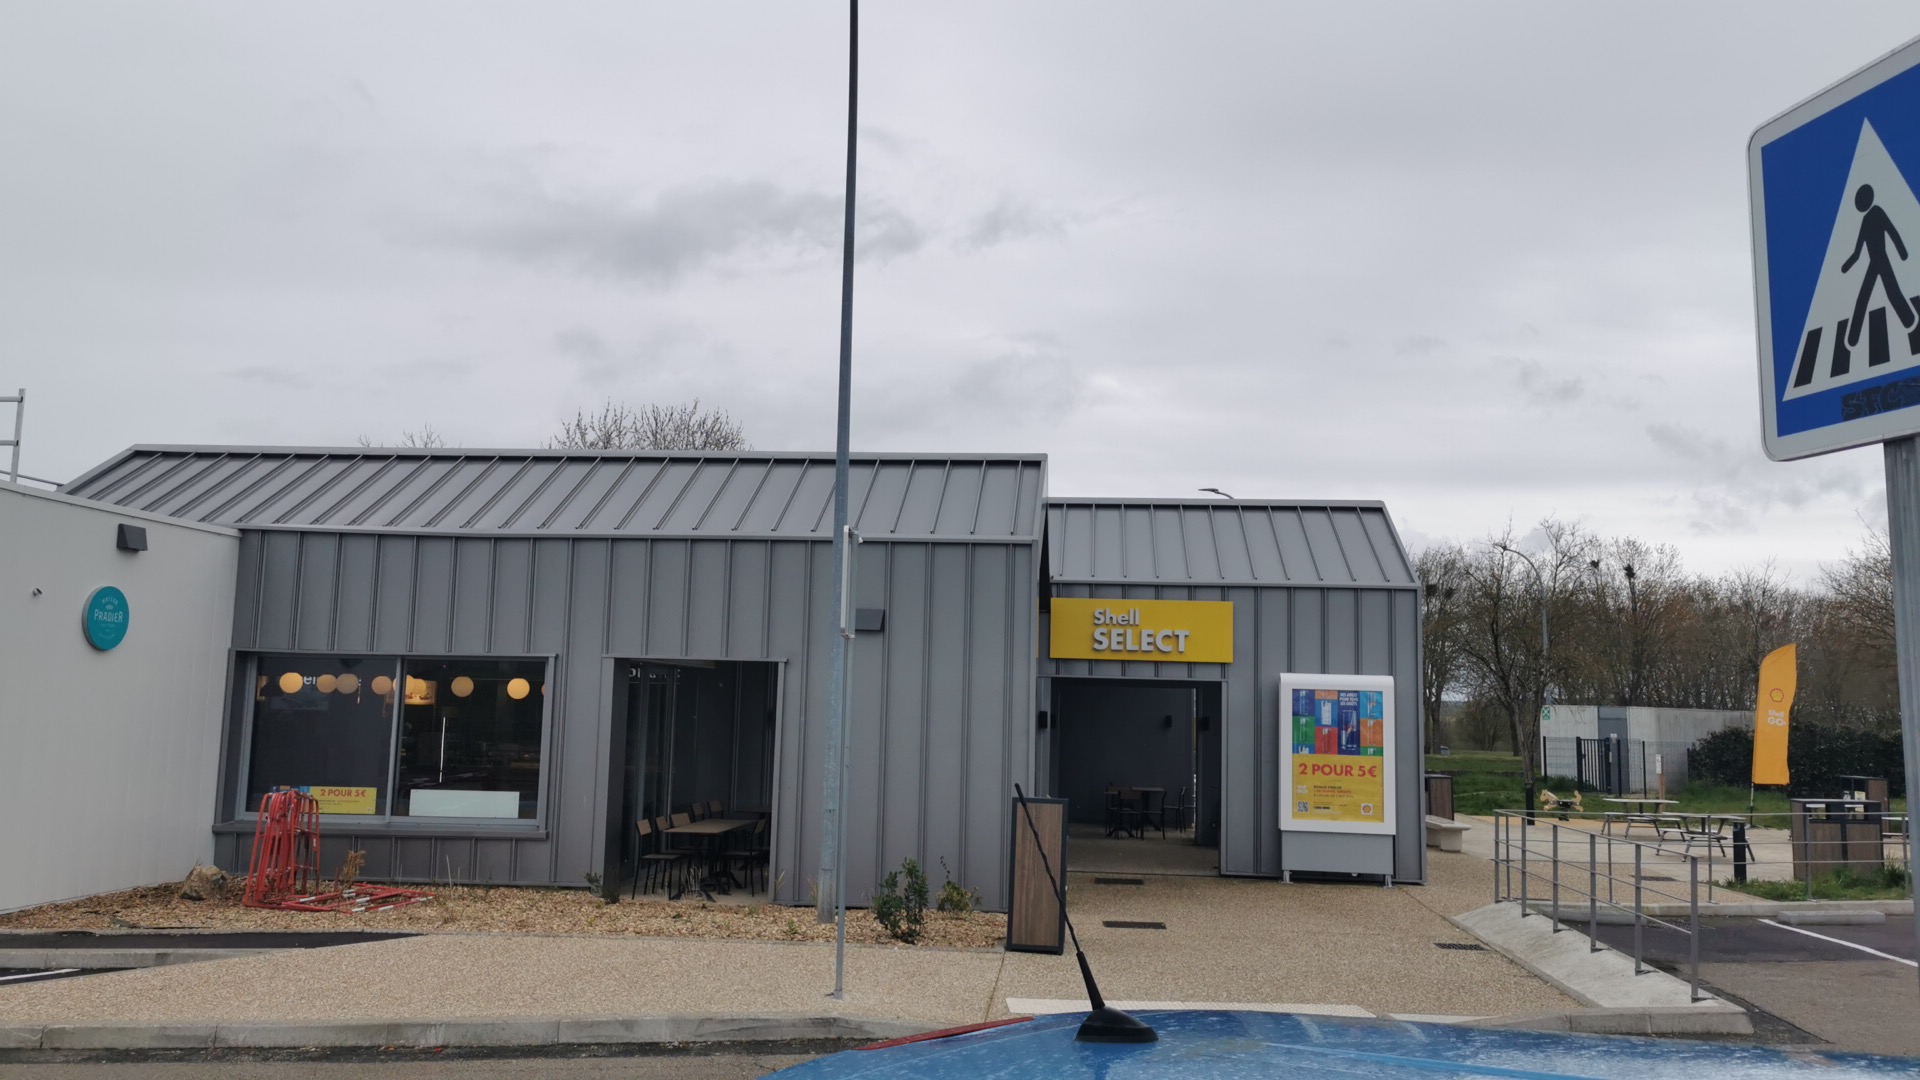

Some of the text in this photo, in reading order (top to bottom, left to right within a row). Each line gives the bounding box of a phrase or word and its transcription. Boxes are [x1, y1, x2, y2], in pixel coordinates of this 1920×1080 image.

[94, 609, 123, 623] PRADIER
[1093, 608, 1140, 626] Shell
[1092, 628, 1190, 653] SELECT
[1298, 763, 1308, 775] 2
[1311, 763, 1354, 777] POUR
[320, 788, 327, 797] 2
[327, 788, 352, 797] POUR
